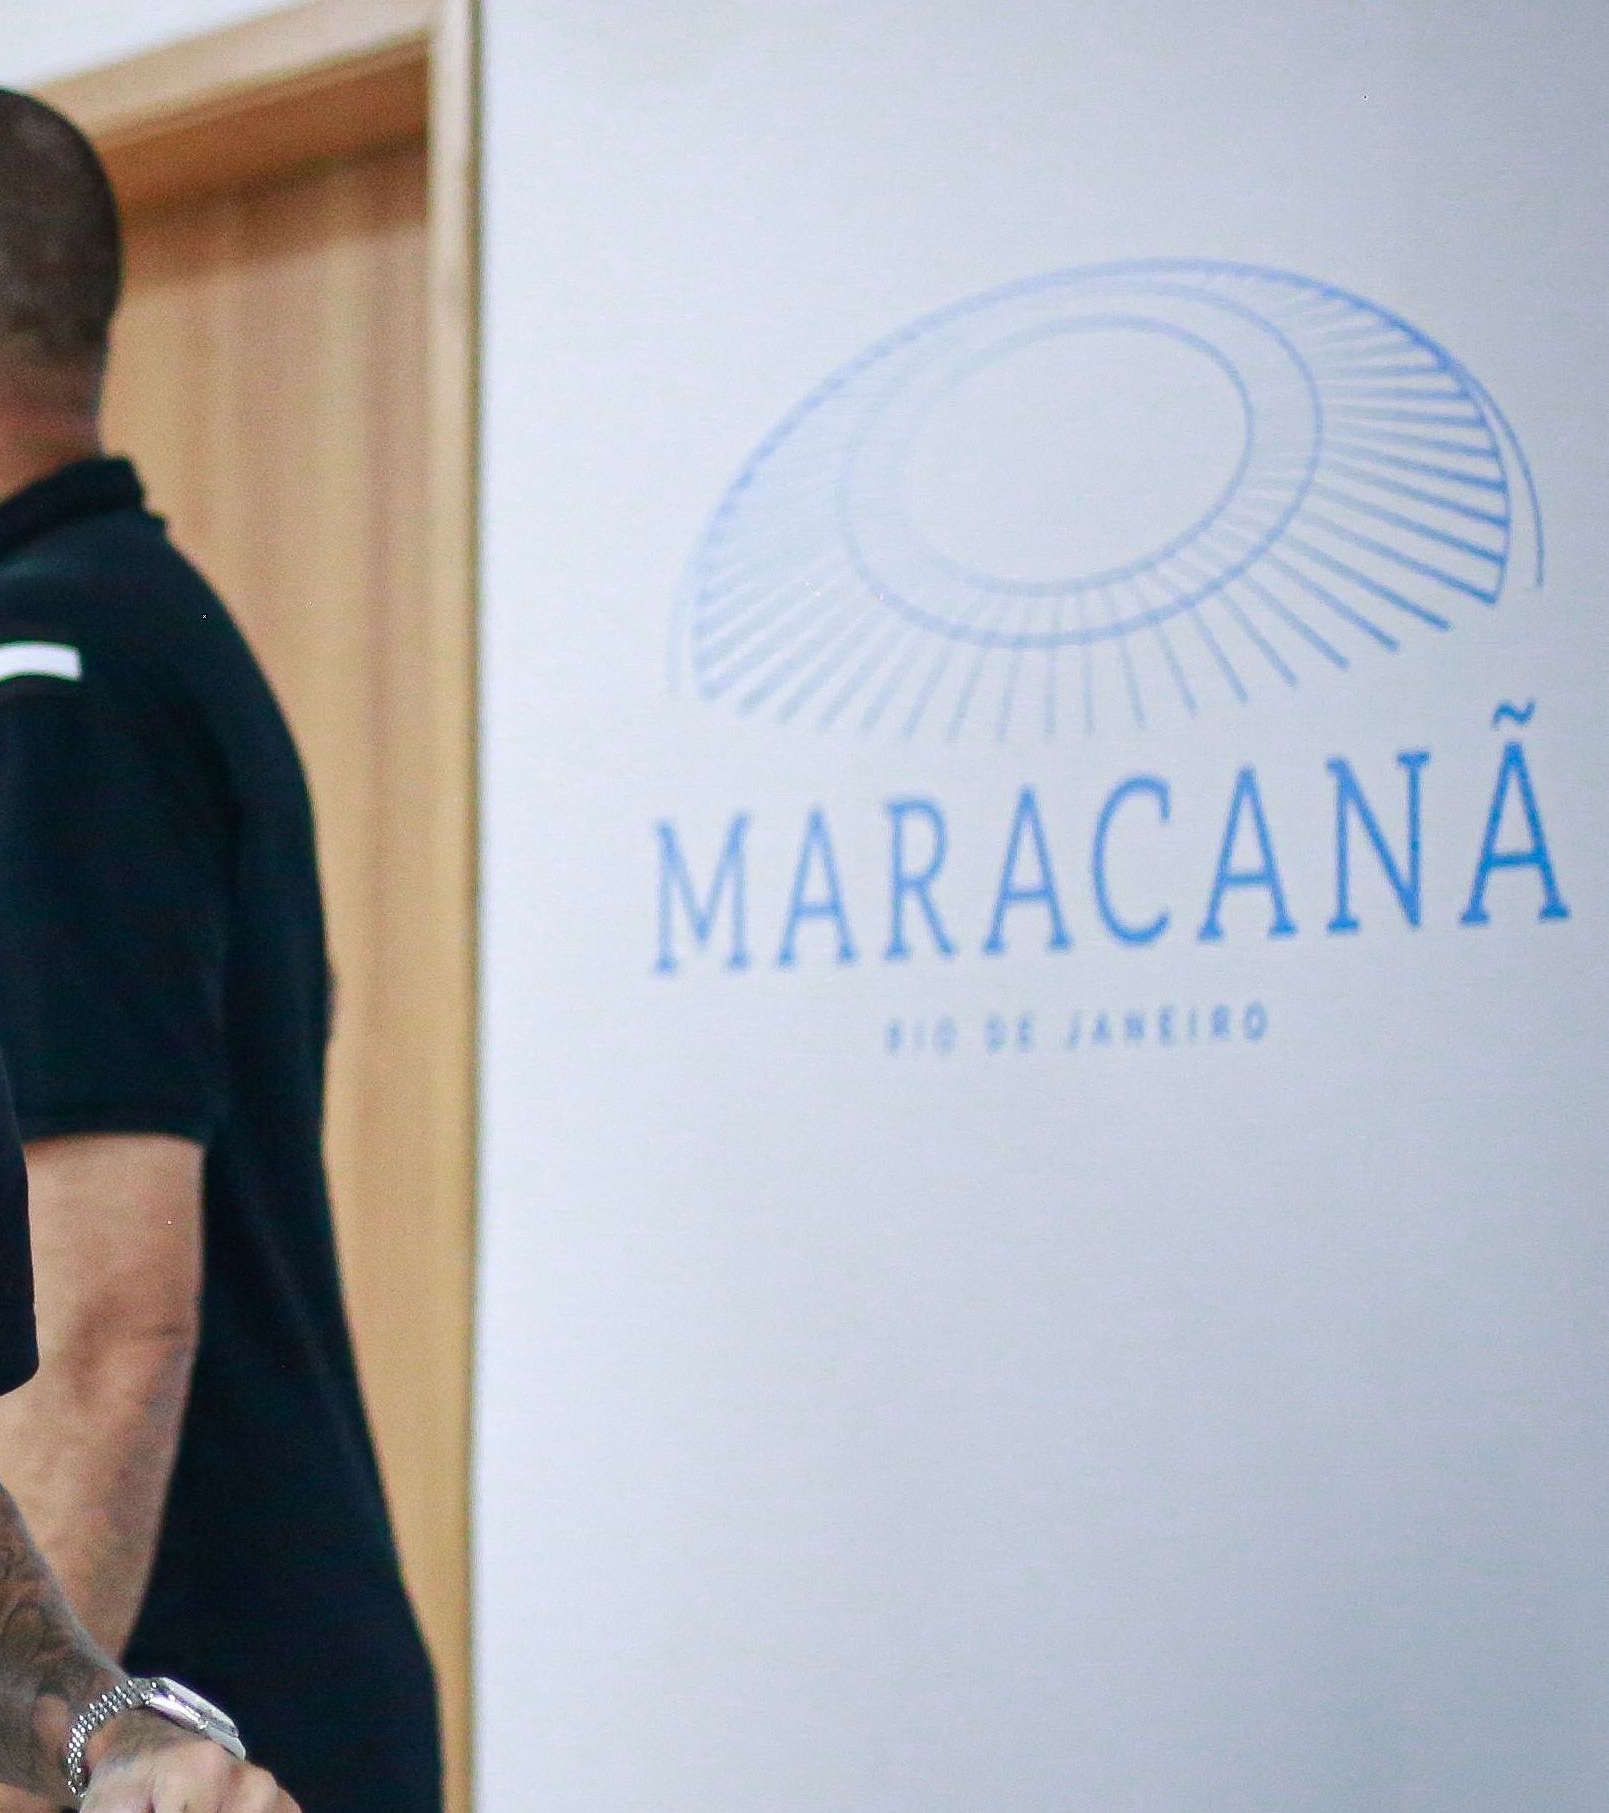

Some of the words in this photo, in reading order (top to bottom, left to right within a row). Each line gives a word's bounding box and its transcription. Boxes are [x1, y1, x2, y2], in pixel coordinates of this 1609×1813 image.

[652, 698, 1571, 976] MARACANÃ
[884, 1013, 958, 1056] RIO
[983, 1010, 1034, 1053] DE
[1060, 1001, 1270, 1053] JANEIRO
